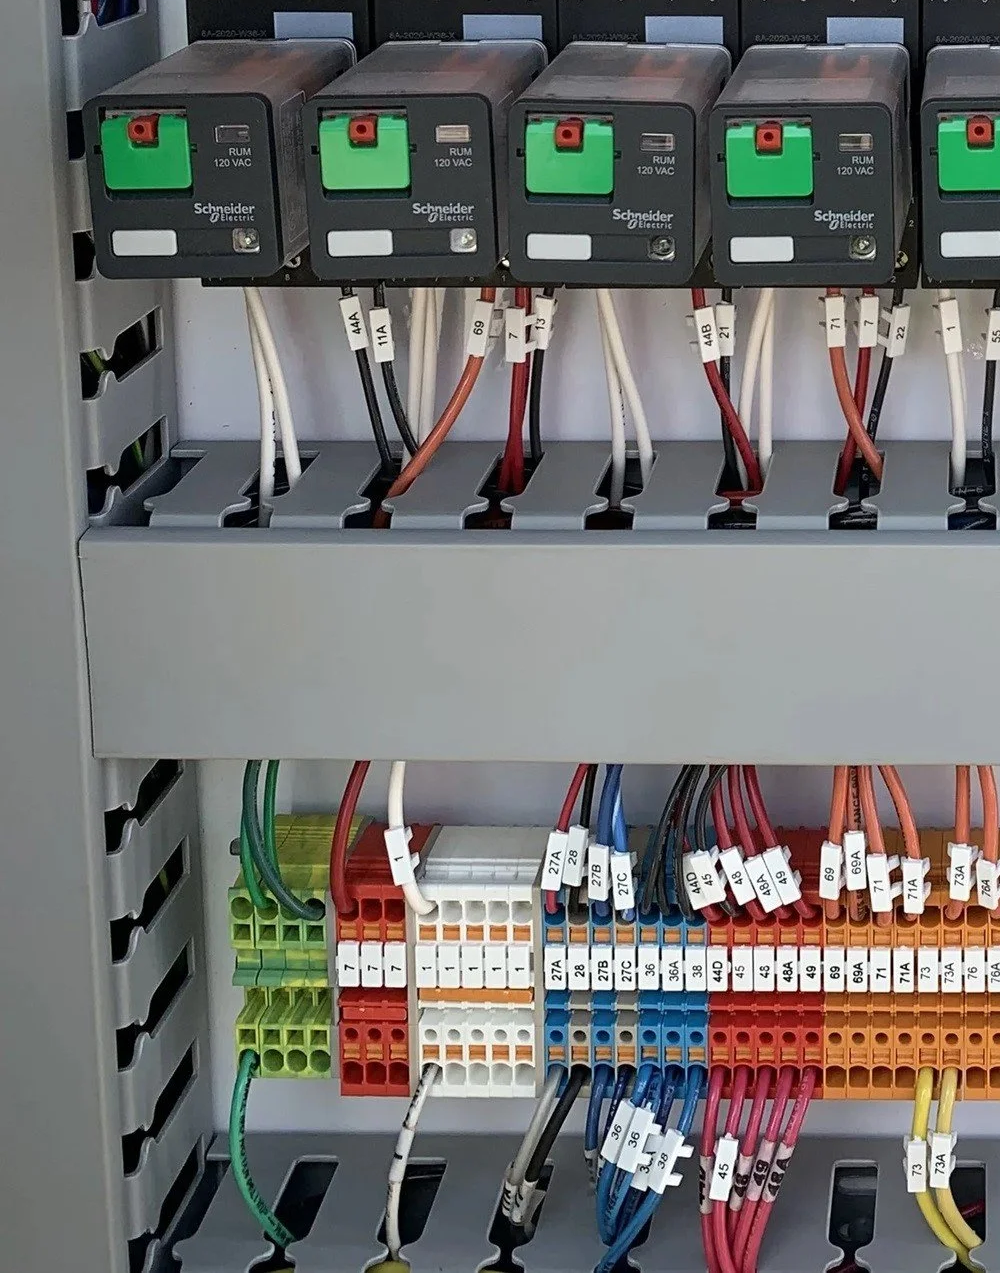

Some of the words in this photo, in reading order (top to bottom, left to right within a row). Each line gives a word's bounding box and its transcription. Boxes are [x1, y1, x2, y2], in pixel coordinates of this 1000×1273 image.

[229, 148, 251, 156] RUM
[214, 159, 230, 167] 120
[232, 159, 252, 167] VAC
[194, 203, 255, 215] Schneider
[220, 213, 254, 222] Electric
[347, 310, 363, 337] 44A
[473, 321, 484, 335] 69
[533, 318, 545, 333] 13
[830, 318, 840, 330] 71
[376, 325, 388, 346] 11A
[699, 324, 713, 348] 44B
[718, 327, 729, 338] 21
[896, 326, 907, 341] 22
[549, 851, 562, 875] 27A
[568, 850, 578, 865] 28
[851, 851, 861, 874] 69A
[591, 864, 601, 887] 27B
[703, 874, 713, 886] 45
[730, 871, 743, 887] 48
[774, 871, 787, 886] 49
[824, 868, 834, 881] 69
[954, 866, 965, 886] 73A
[617, 873, 629, 896] 27C
[686, 872, 700, 894] 44D
[759, 875, 771, 895] 48A
[873, 880, 884, 893] 71
[908, 879, 917, 899] 71A
[981, 880, 991, 897] 76A
[551, 960, 562, 981] 27A
[574, 964, 585, 977] 28
[598, 960, 608, 981] 27B
[621, 961, 632, 982] 27C
[645, 964, 655, 976] 36
[669, 961, 679, 981] 36A
[692, 965, 702, 978] 38
[712, 961, 723, 982] 44D
[735, 966, 745, 979] 45
[759, 965, 770, 978] 48
[783, 961, 793, 982] 48A
[806, 966, 816, 979] 49
[830, 966, 840, 979] 69
[853, 962, 863, 983] 69A
[876, 968, 886, 979] 71
[900, 963, 910, 983] 71A
[920, 967, 930, 979] 73
[944, 962, 954, 984] 73A
[967, 967, 977, 979] 76
[991, 962, 1000, 983] 76A
[611, 1124, 622, 1140] 36
[627, 1130, 640, 1148] 36
[656, 1152, 668, 1169] 38
[935, 1154, 946, 1174] 73A
[718, 1164, 729, 1180] 45
[753, 1160, 769, 1186] 49
[912, 1164, 922, 1176] 73
